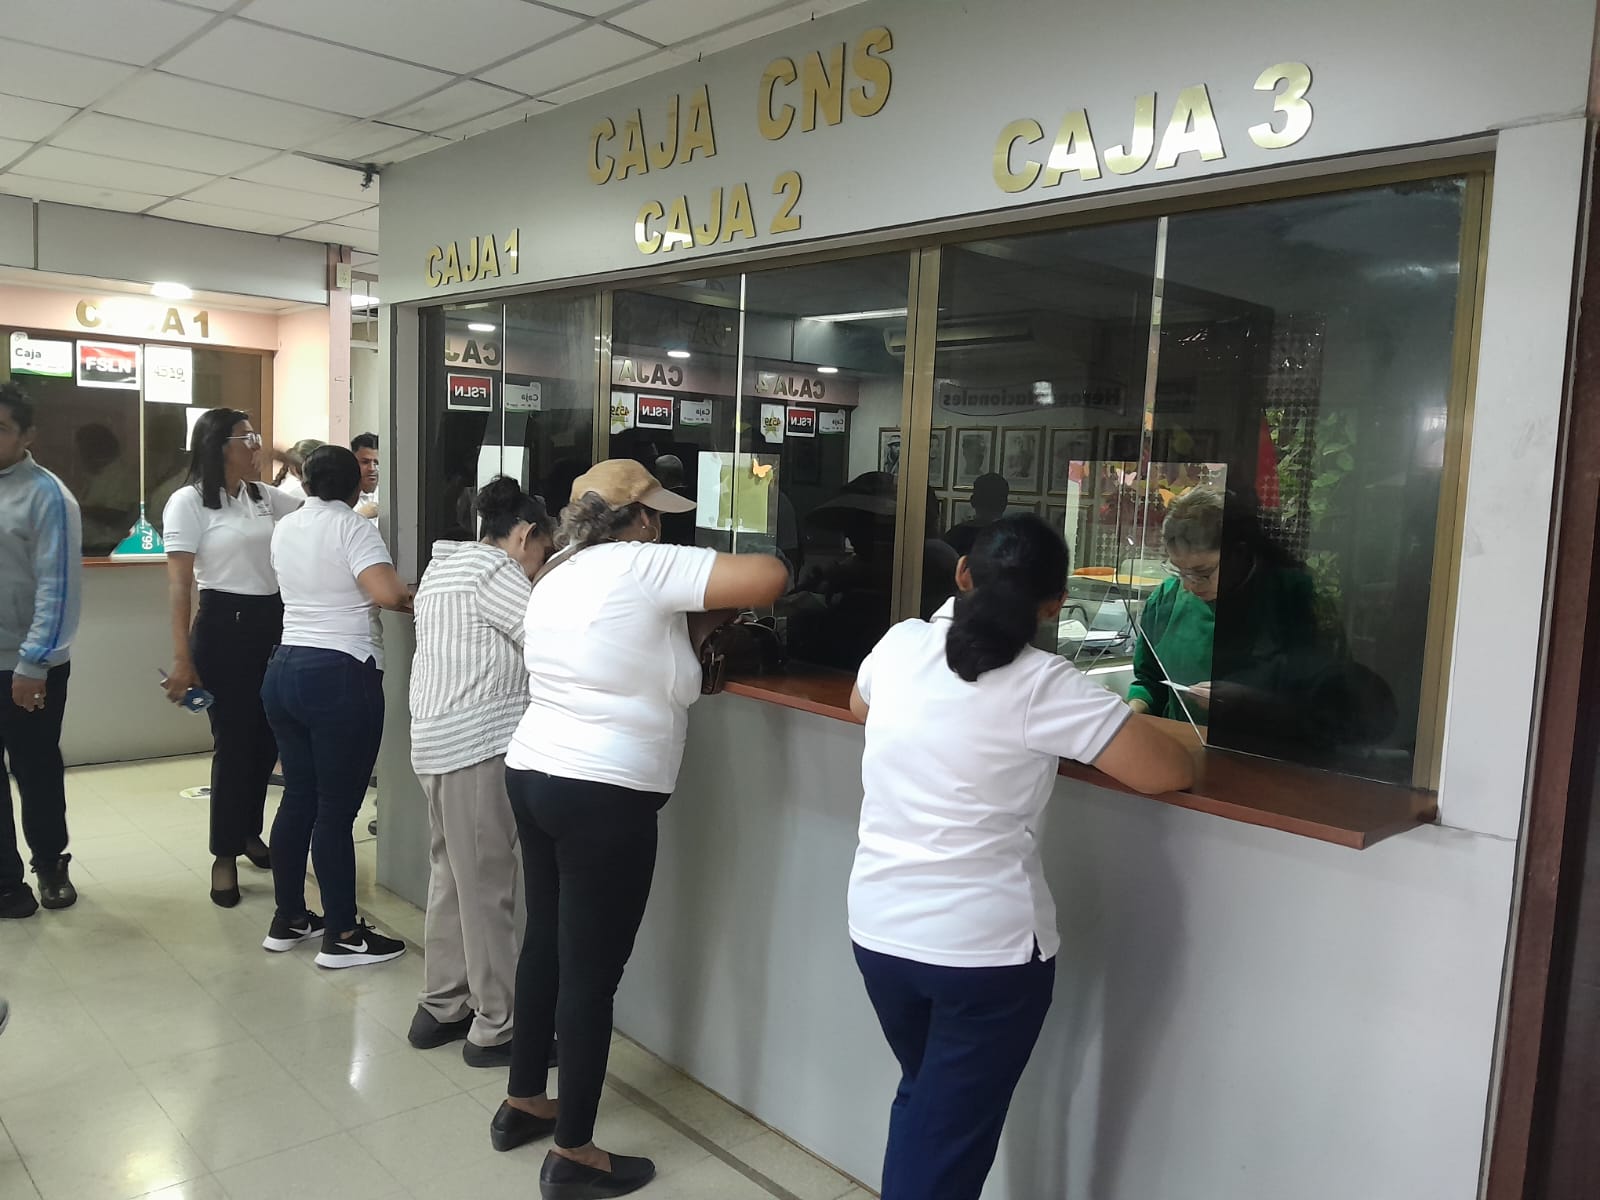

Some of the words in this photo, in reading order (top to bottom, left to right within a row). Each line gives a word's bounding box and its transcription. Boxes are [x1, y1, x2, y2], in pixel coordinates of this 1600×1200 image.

[588, 84, 717, 185] CAJA
[758, 26, 893, 141] CNS
[993, 83, 1227, 193] CAJA
[1248, 61, 1313, 149] 3
[634, 182, 757, 255] CAJA
[769, 171, 802, 234] 2
[76, 300, 185, 335] CA
[15, 347, 42, 360] Caja
[86, 356, 132, 374] FSLN
